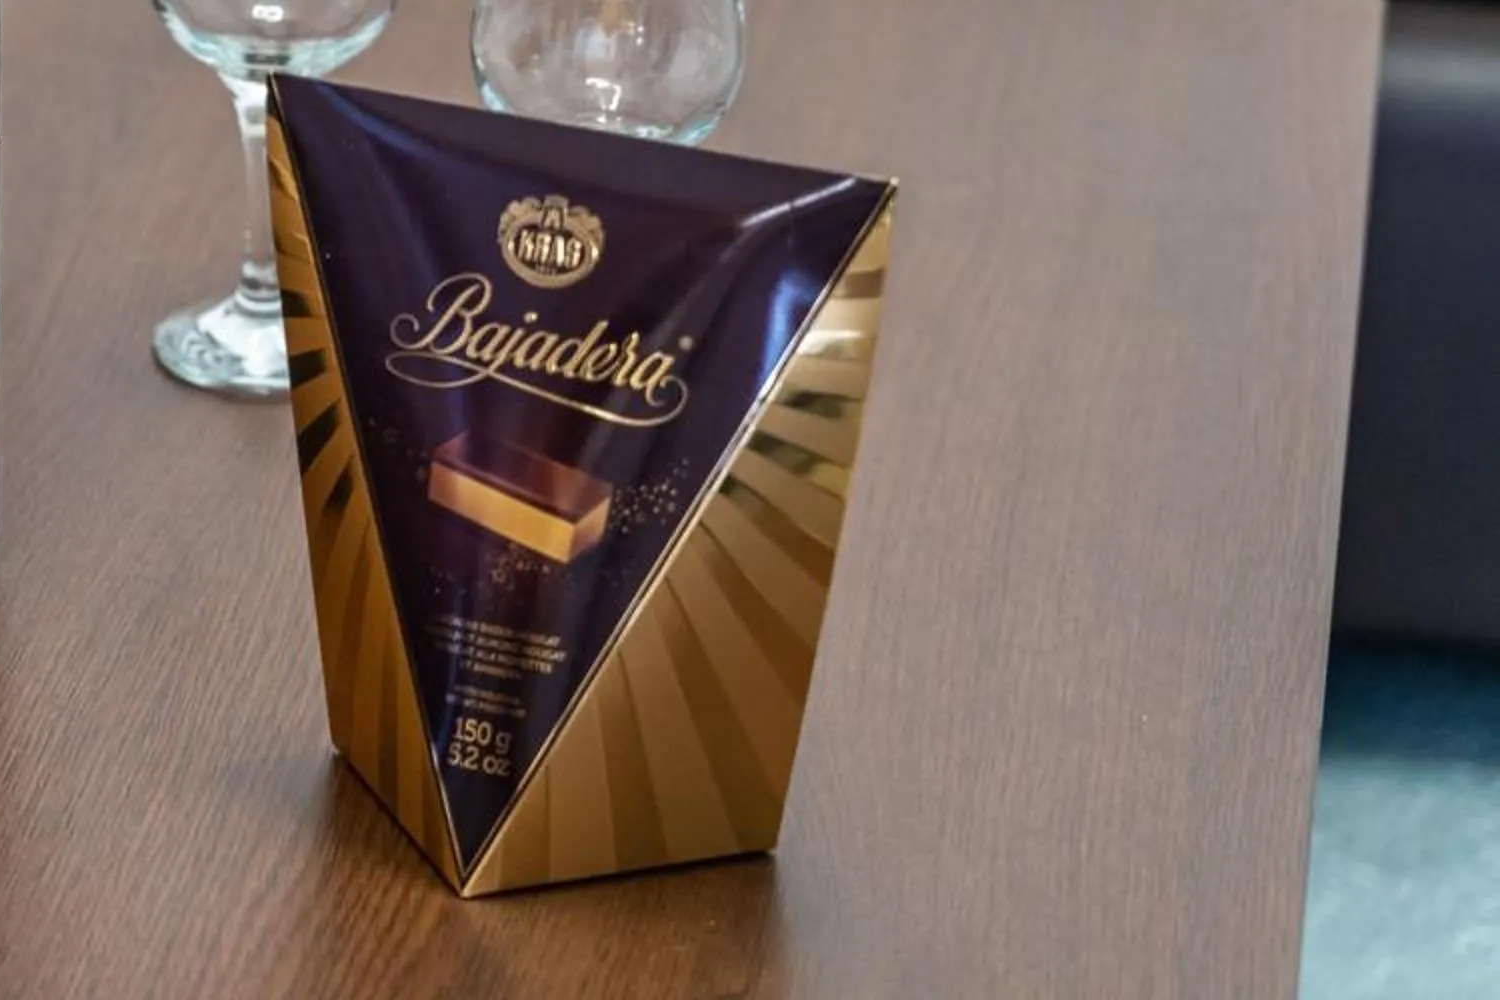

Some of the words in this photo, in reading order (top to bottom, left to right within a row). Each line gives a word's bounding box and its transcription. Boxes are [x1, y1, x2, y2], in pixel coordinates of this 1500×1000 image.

[386, 273, 688, 427] Bajadera
[454, 716, 493, 745] 150
[495, 731, 513, 755] g
[448, 741, 480, 770] 5.2
